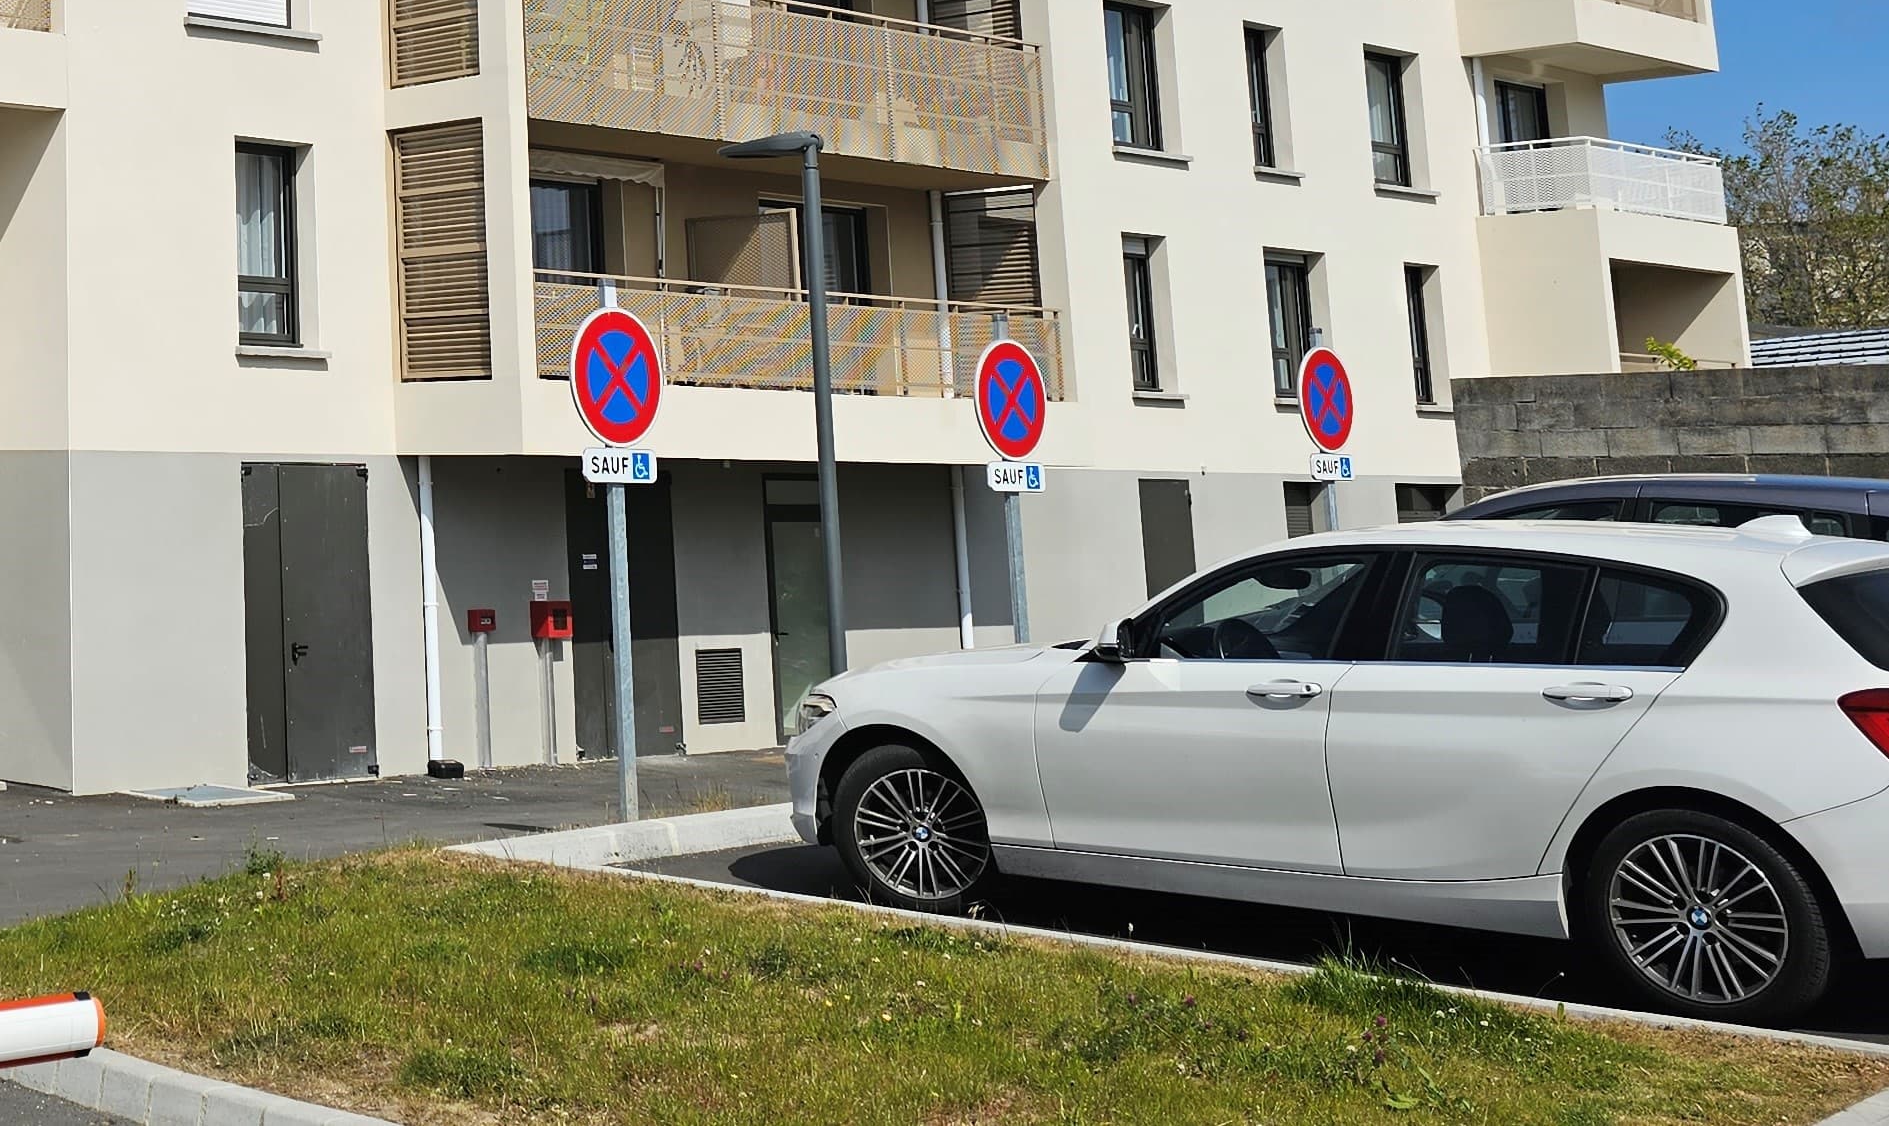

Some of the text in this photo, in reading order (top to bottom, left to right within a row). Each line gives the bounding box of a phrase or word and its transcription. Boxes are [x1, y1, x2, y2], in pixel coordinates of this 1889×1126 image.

[591, 456, 629, 474] SAUF
[1315, 459, 1339, 474] SAUF
[994, 468, 1024, 484] SAUF
